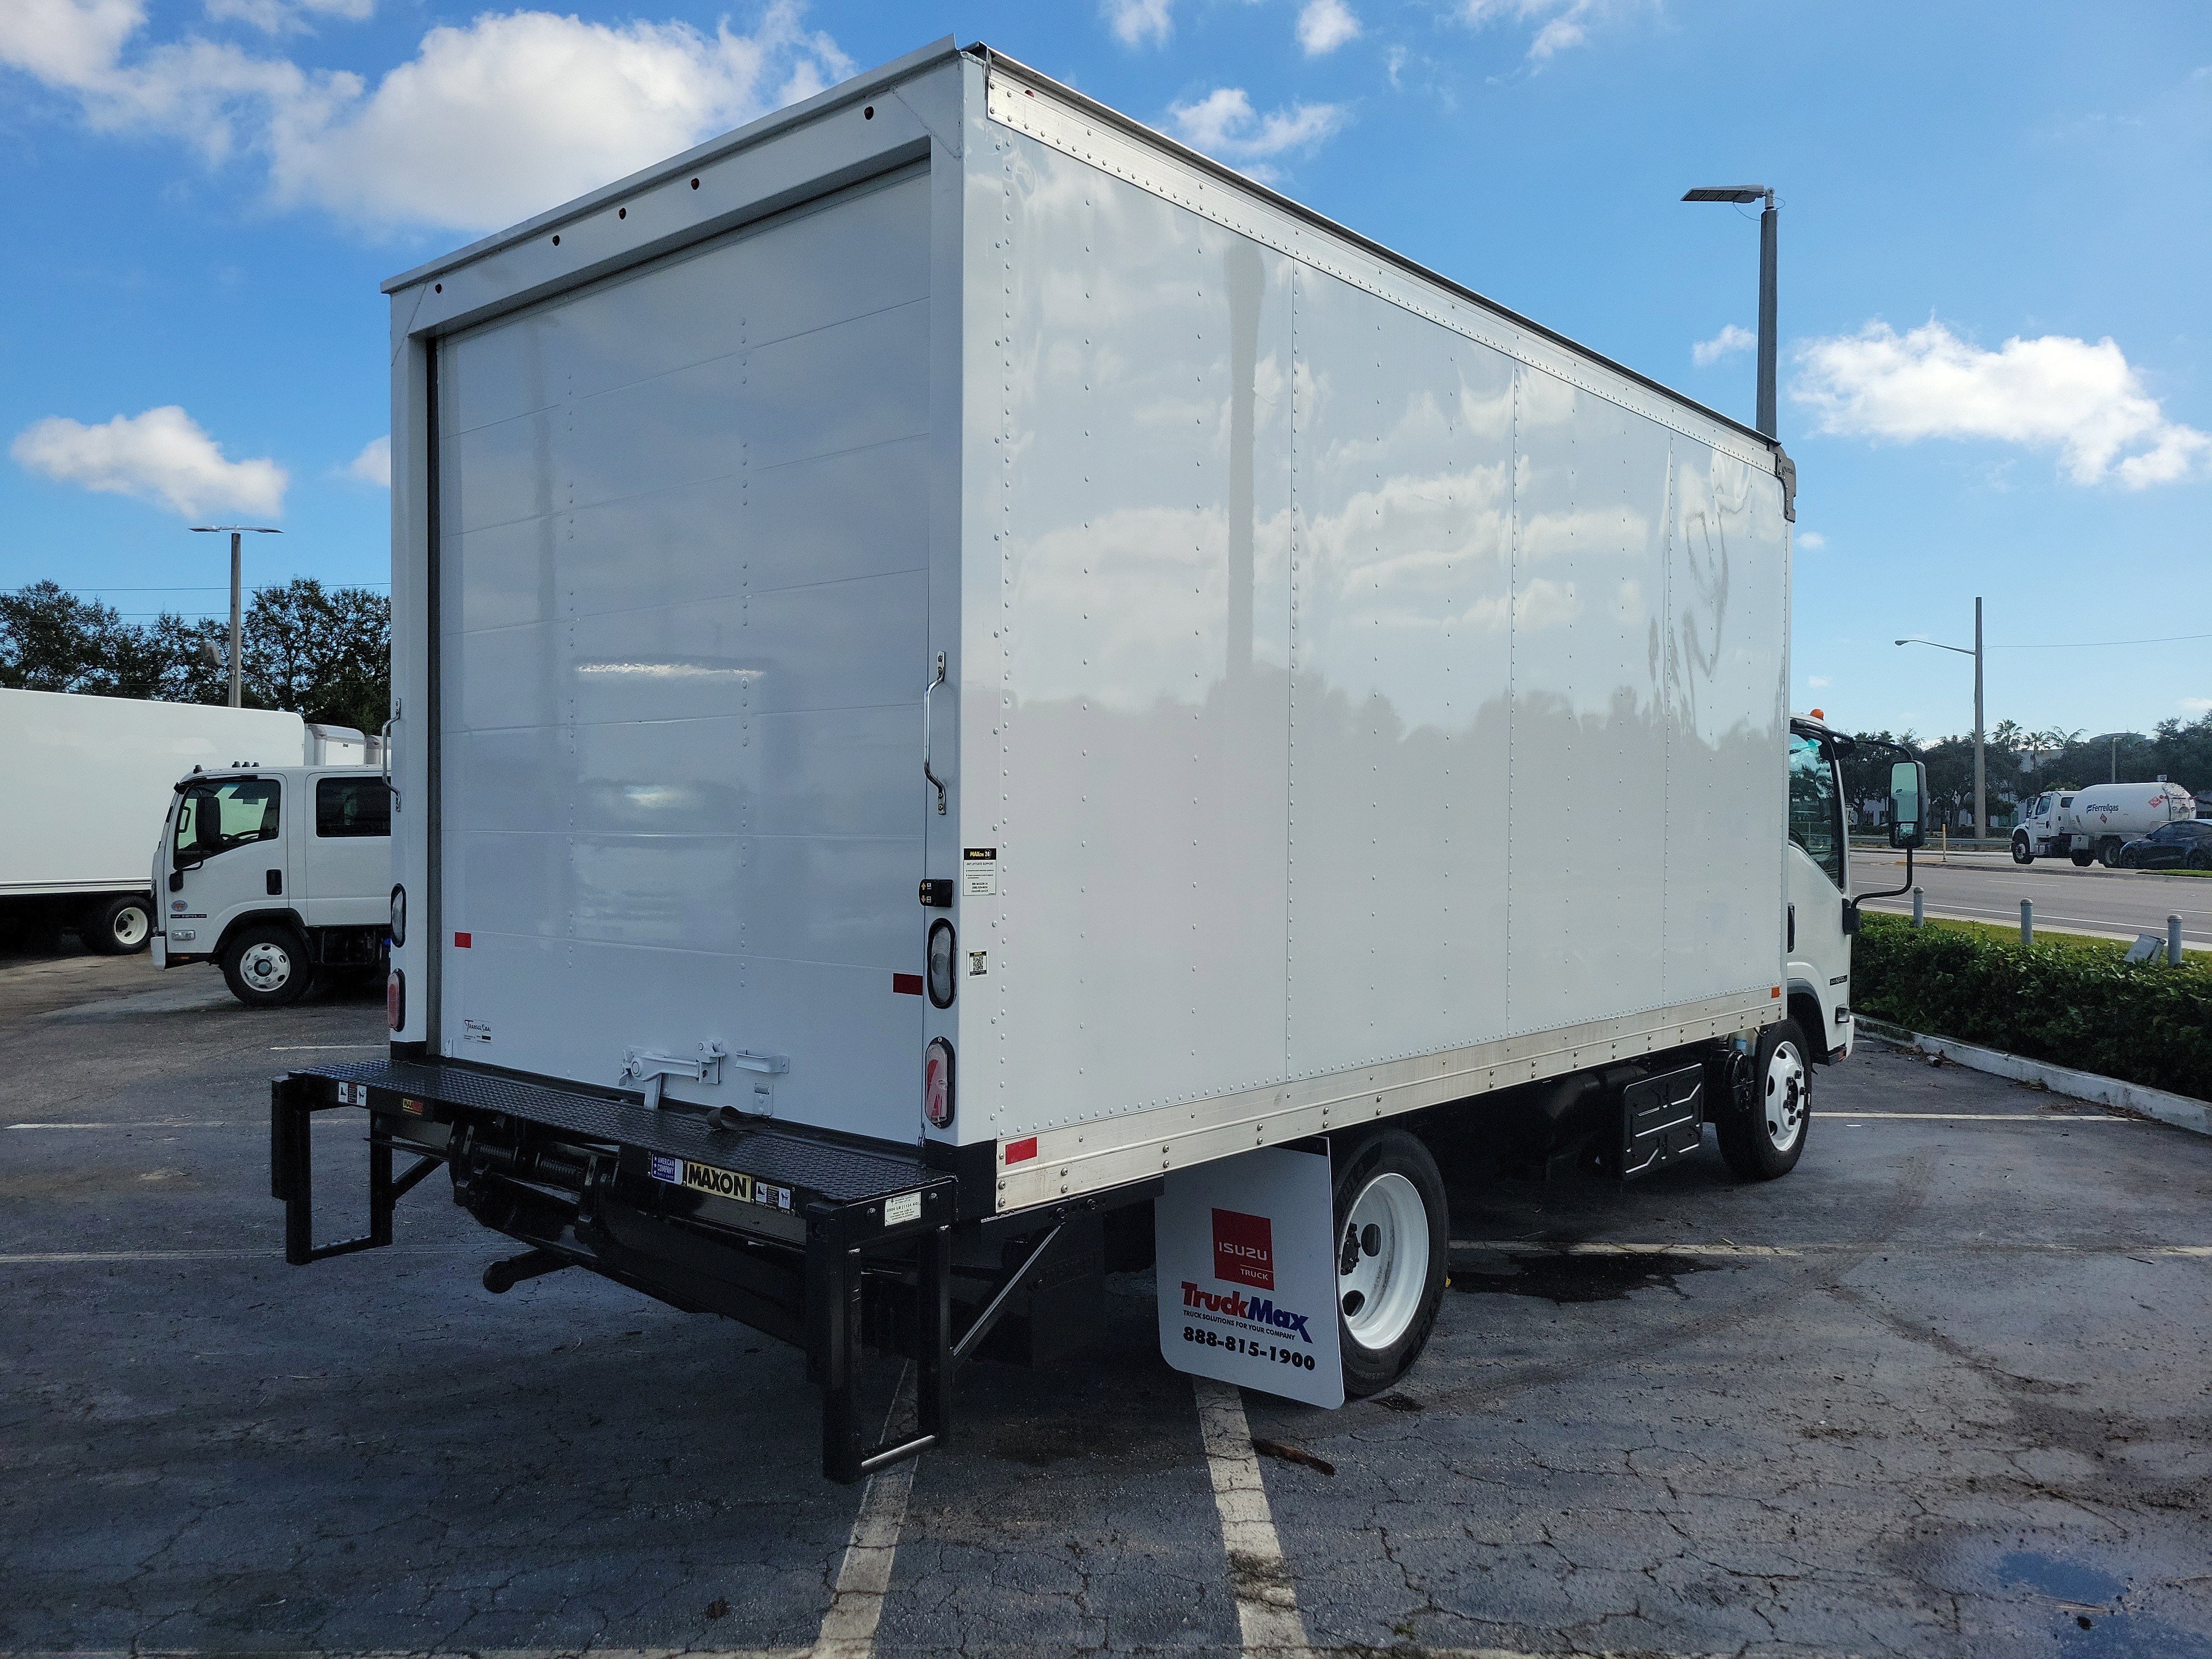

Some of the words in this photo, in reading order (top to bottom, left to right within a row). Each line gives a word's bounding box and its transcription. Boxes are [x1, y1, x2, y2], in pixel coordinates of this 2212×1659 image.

[2092, 804, 2119, 813] Ferrellgas
[688, 1164, 747, 1198] MAXON
[1219, 1242, 1267, 1261] ISUZU
[1240, 1268, 1268, 1280] TRUCK
[1181, 1280, 1313, 1344] TruckMax
[1183, 1310, 1202, 1319] TRUCK
[1202, 1313, 1234, 1326] SOLUTIONS
[1235, 1321, 1248, 1329] FOR
[1248, 1324, 1265, 1334] YOUR
[1266, 1328, 1295, 1340] COMPANY
[1183, 1326, 1316, 1371] 888-815-1900
